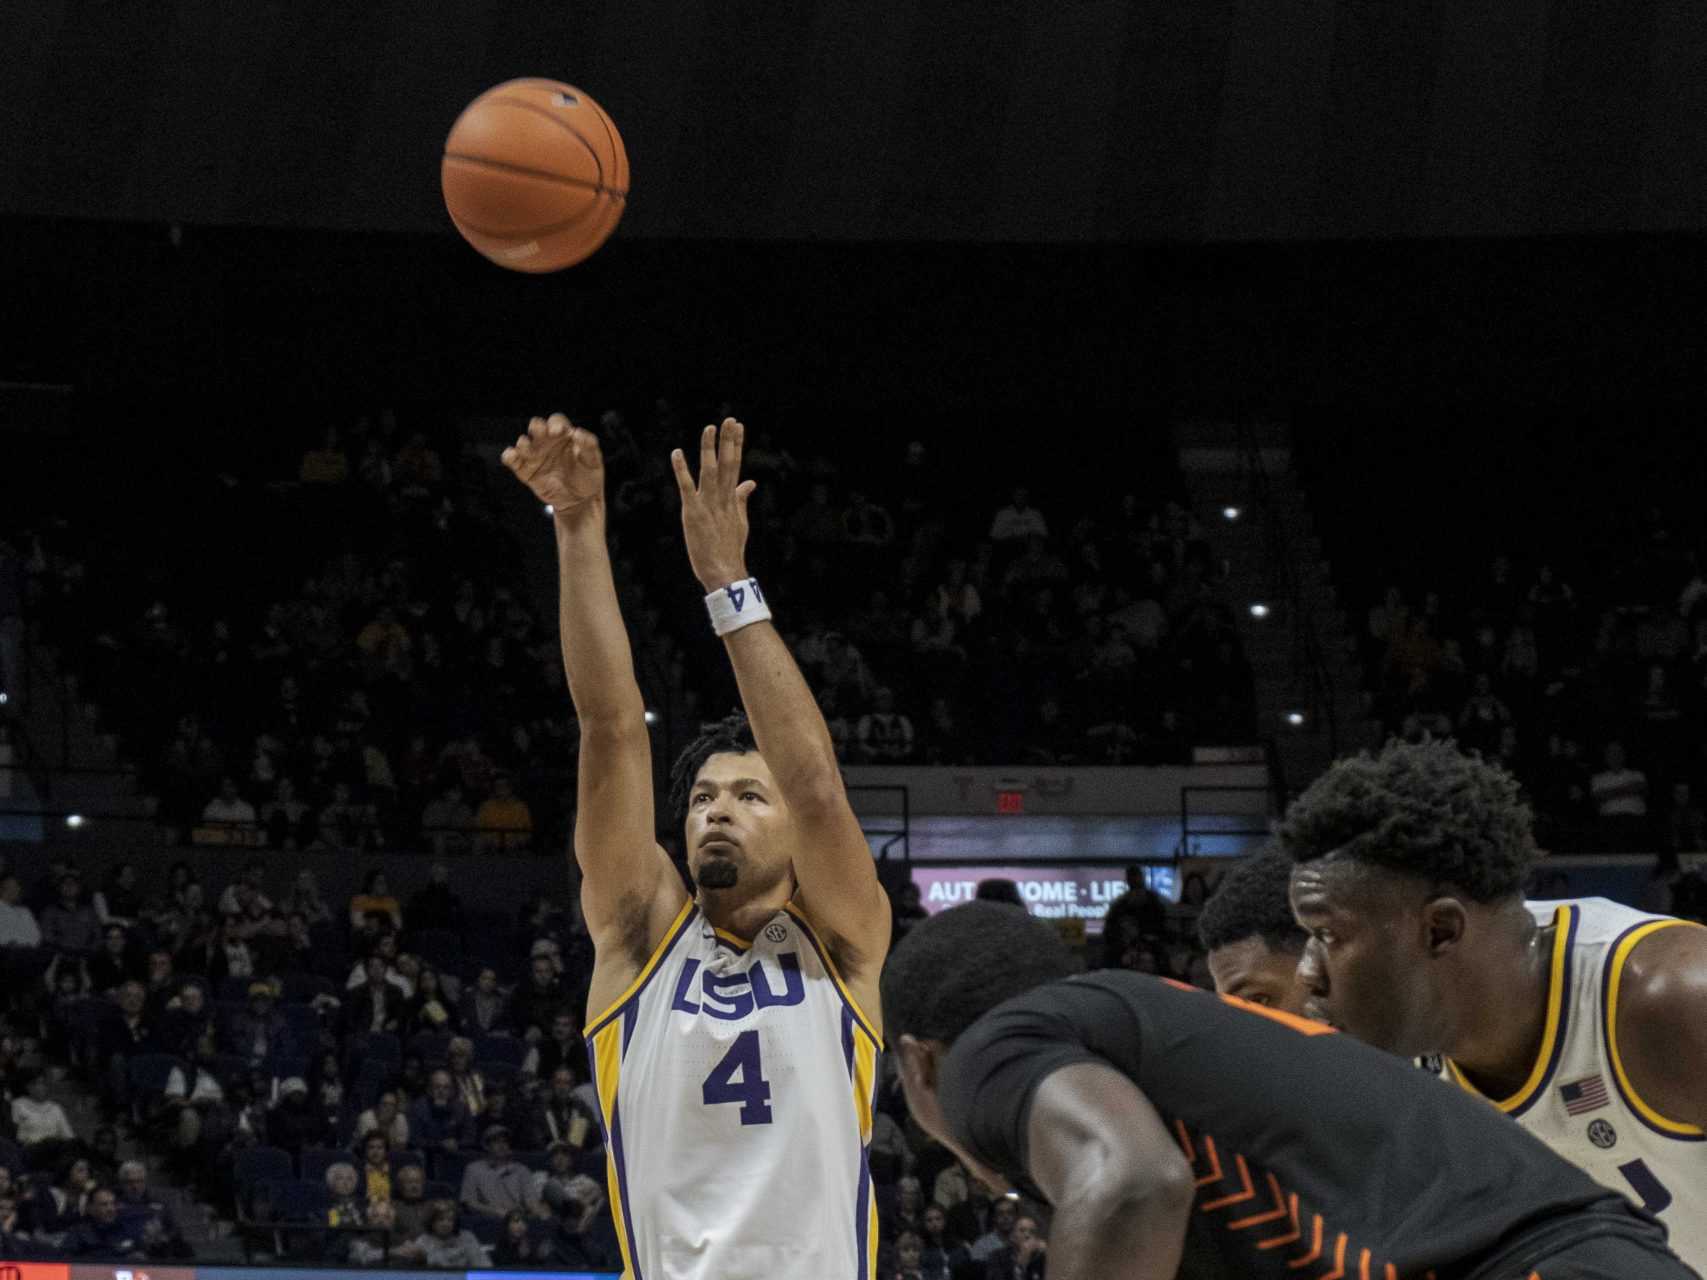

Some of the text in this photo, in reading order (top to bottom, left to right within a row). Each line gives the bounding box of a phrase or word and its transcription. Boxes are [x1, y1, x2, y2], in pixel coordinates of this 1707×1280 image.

[928, 881, 976, 902] AUT
[1090, 881, 1130, 902] LIF
[672, 952, 805, 1021] LSU
[702, 1030, 773, 1125] 4
